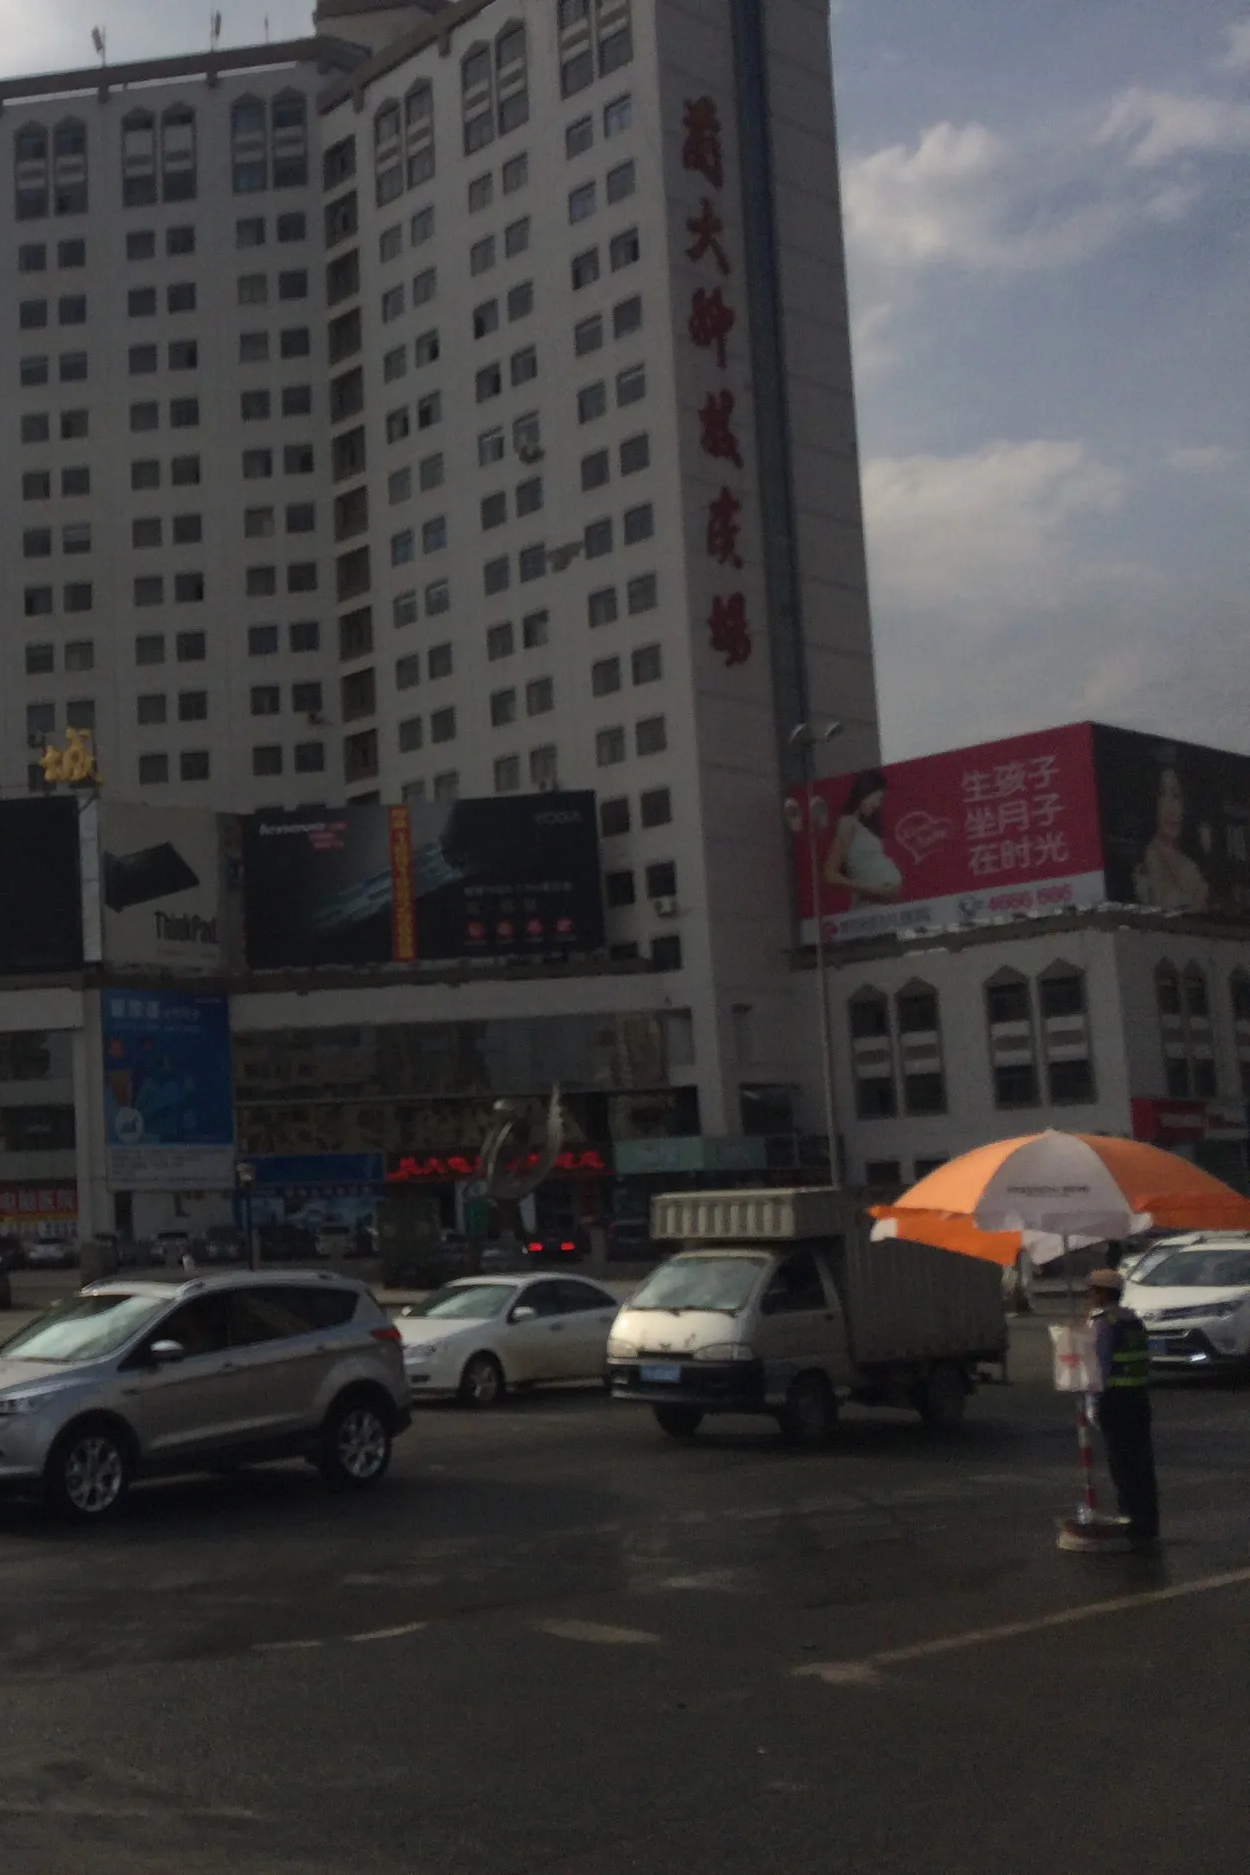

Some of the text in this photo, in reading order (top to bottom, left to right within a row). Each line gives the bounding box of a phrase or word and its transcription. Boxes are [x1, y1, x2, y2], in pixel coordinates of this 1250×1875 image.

[961, 755, 1061, 803] 生孩子
[965, 794, 1065, 841] 坐月子
[969, 831, 1069, 876] 在时光
